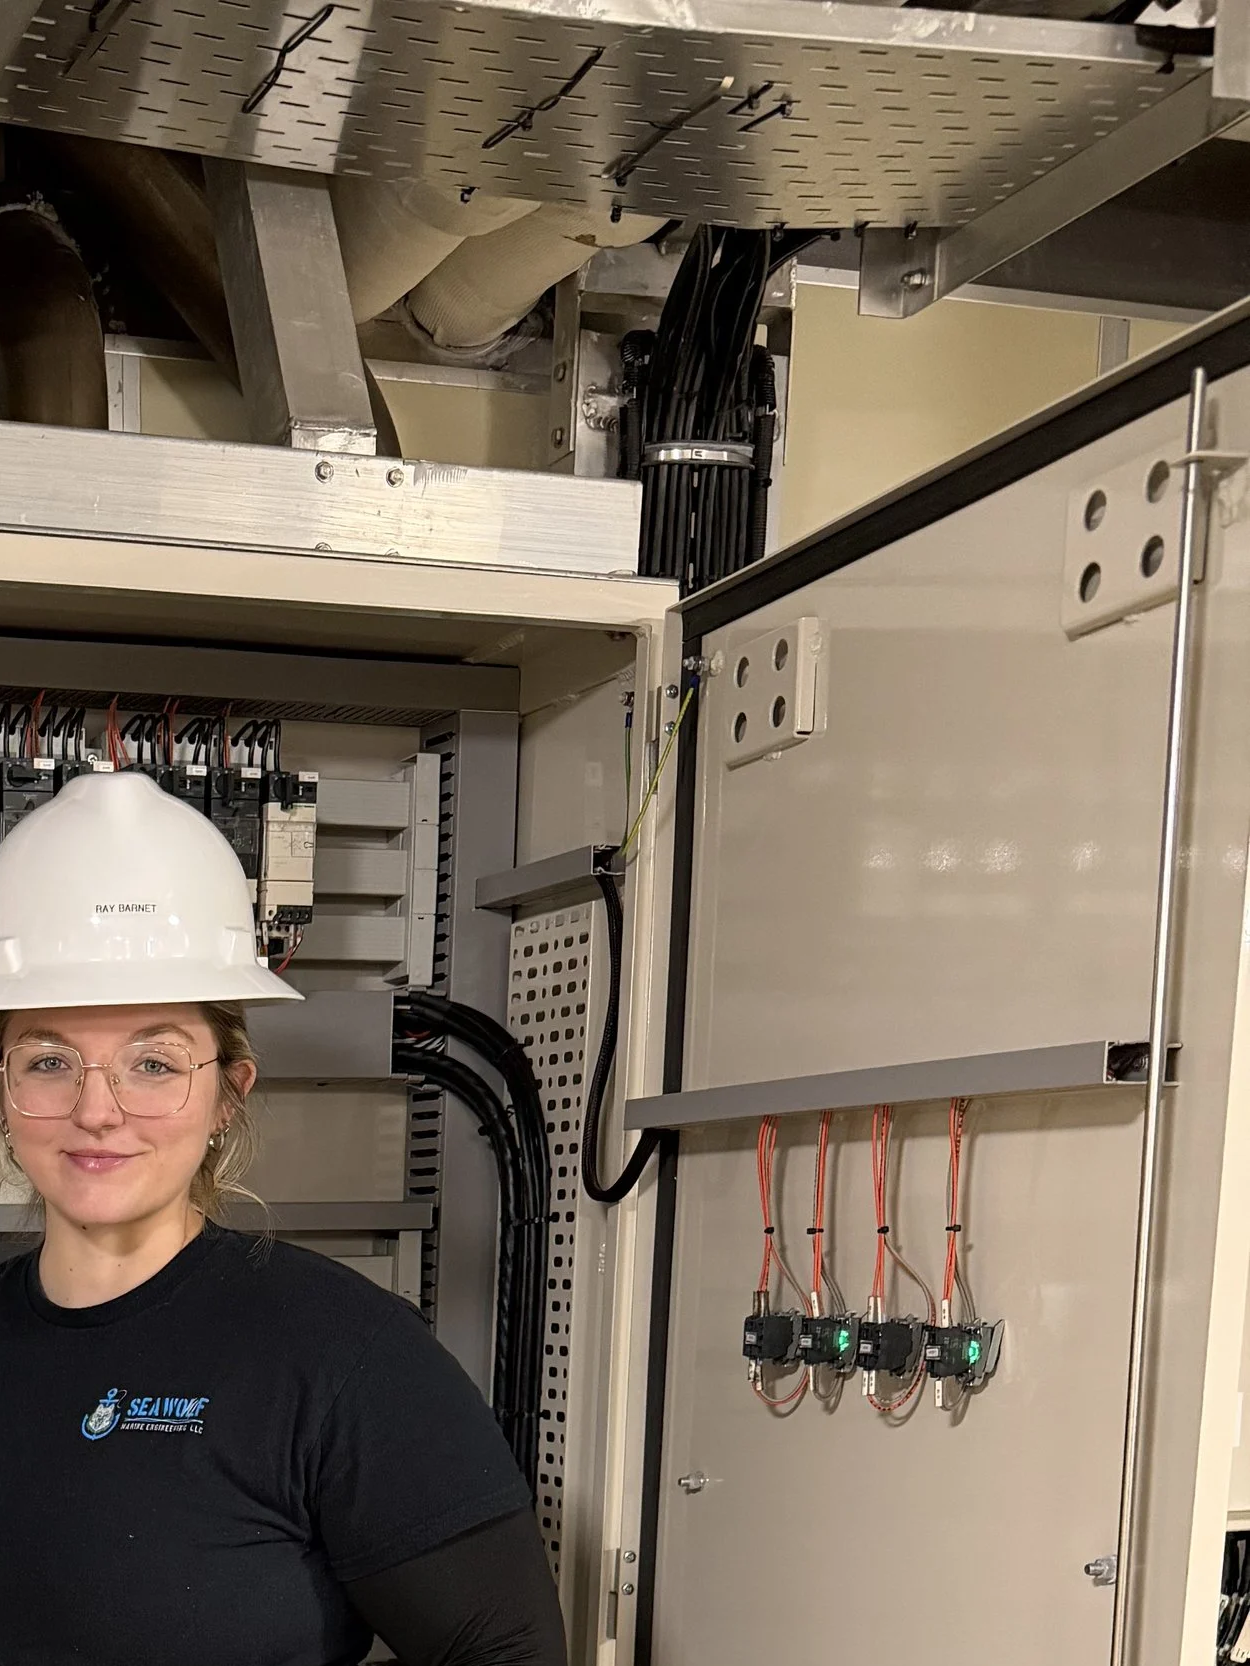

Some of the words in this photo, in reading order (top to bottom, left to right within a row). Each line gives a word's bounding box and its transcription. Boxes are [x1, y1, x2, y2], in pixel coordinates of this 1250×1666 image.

[95, 904, 115, 913] RAY
[119, 904, 157, 912] BARNET
[190, 1424, 204, 1434] LLC
